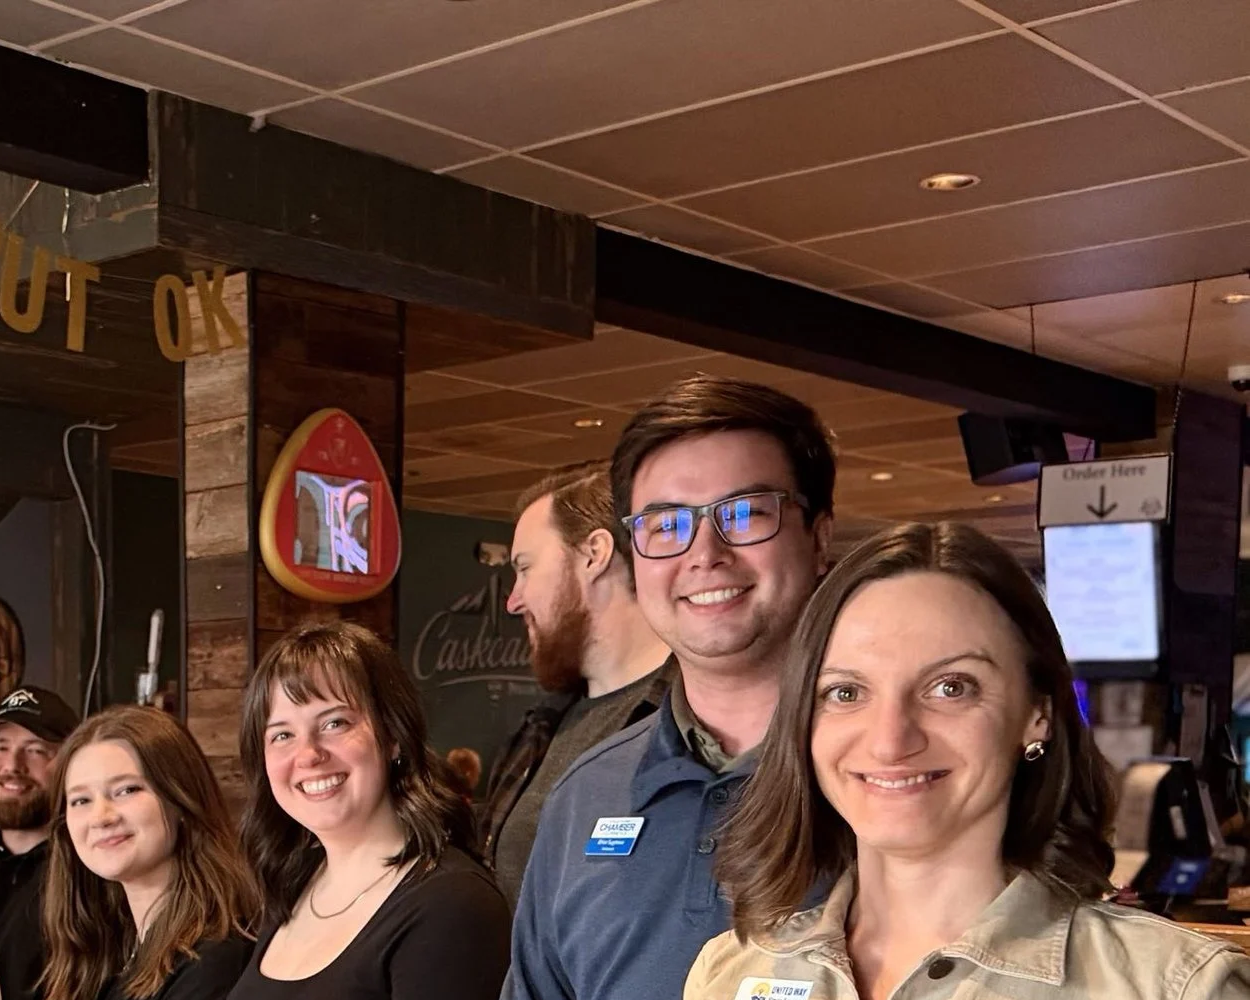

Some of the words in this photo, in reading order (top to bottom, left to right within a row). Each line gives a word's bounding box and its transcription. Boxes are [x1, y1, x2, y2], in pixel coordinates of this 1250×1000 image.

[153, 264, 246, 363] OK
[1062, 465, 1106, 481] Order
[1110, 462, 1147, 478] Here
